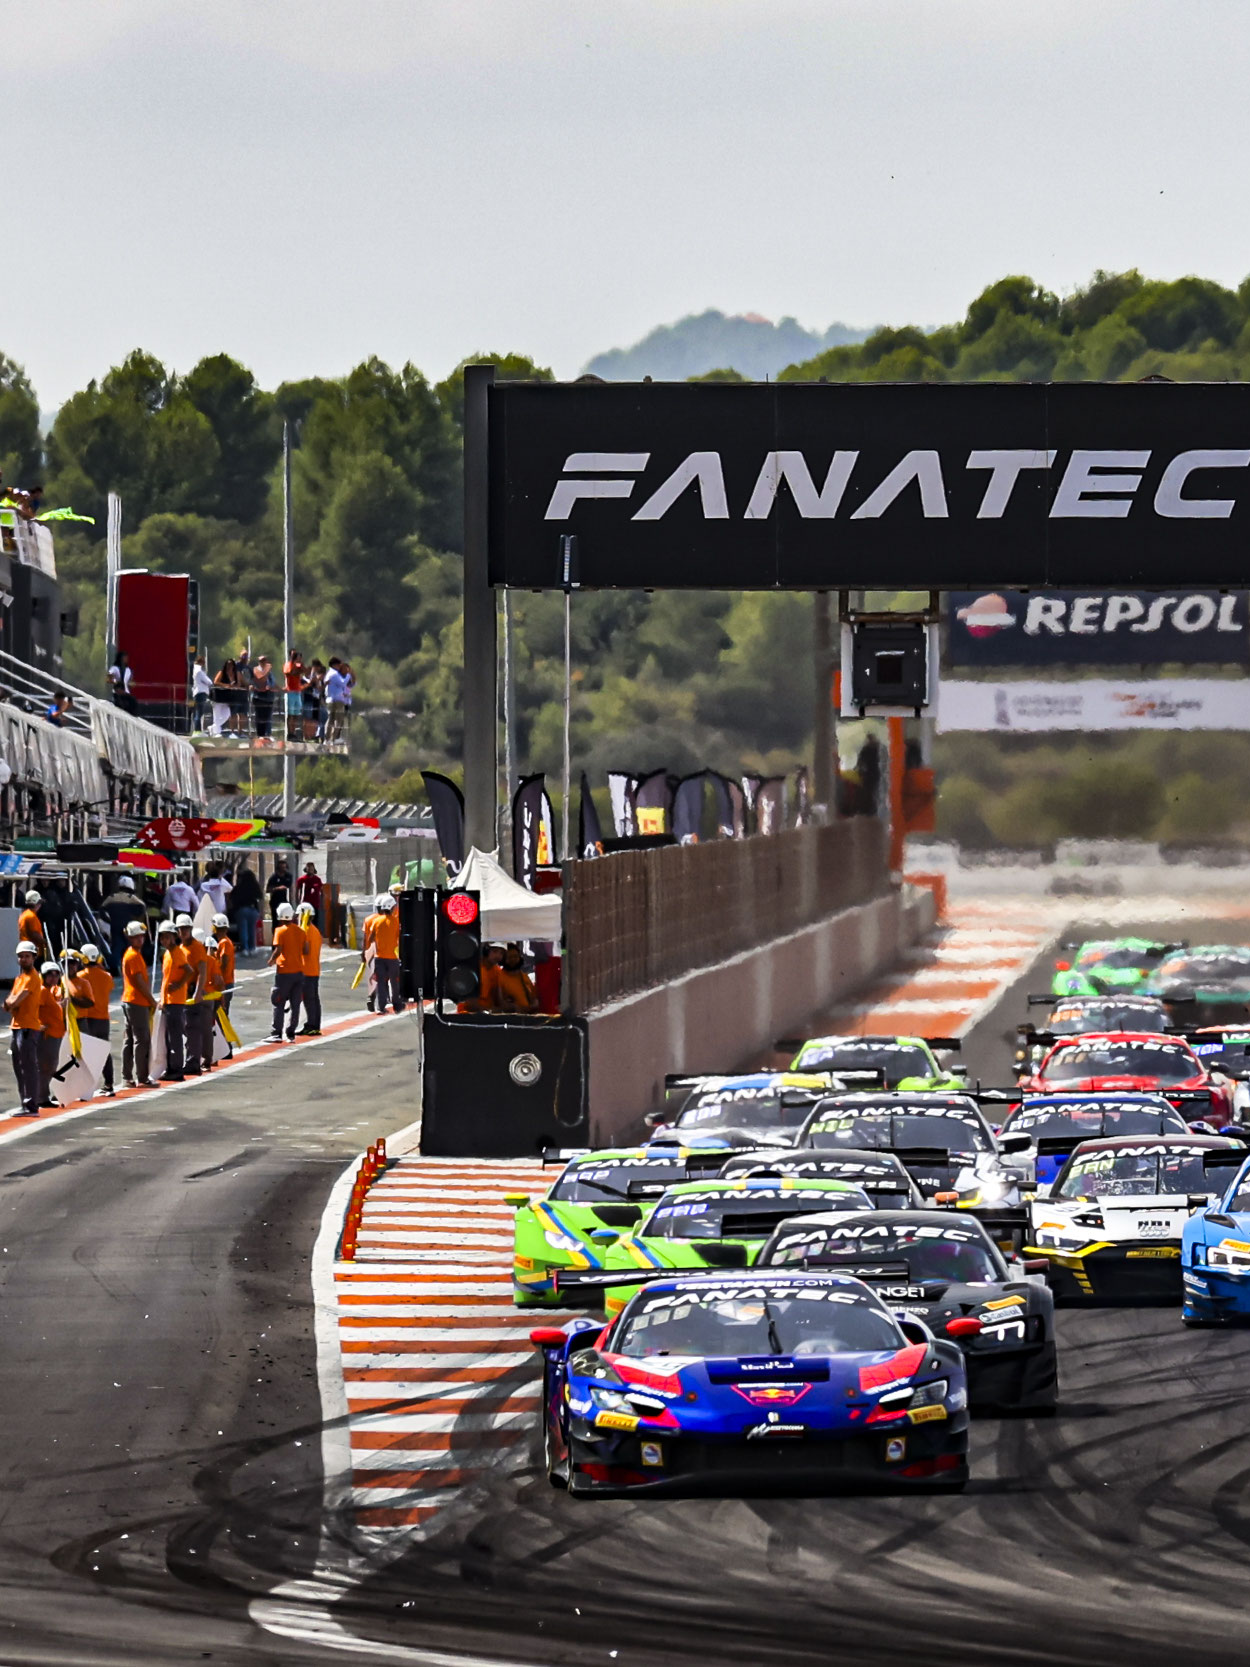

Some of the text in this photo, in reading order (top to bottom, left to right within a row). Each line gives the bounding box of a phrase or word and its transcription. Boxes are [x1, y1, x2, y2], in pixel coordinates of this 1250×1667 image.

[1023, 594, 1243, 636] REPSOL
[1073, 1145, 1213, 1165] FANATE
[672, 1189, 856, 1204] FANATEC
[776, 1226, 979, 1251] FANATEC
[643, 1288, 866, 1314] FANATEC
